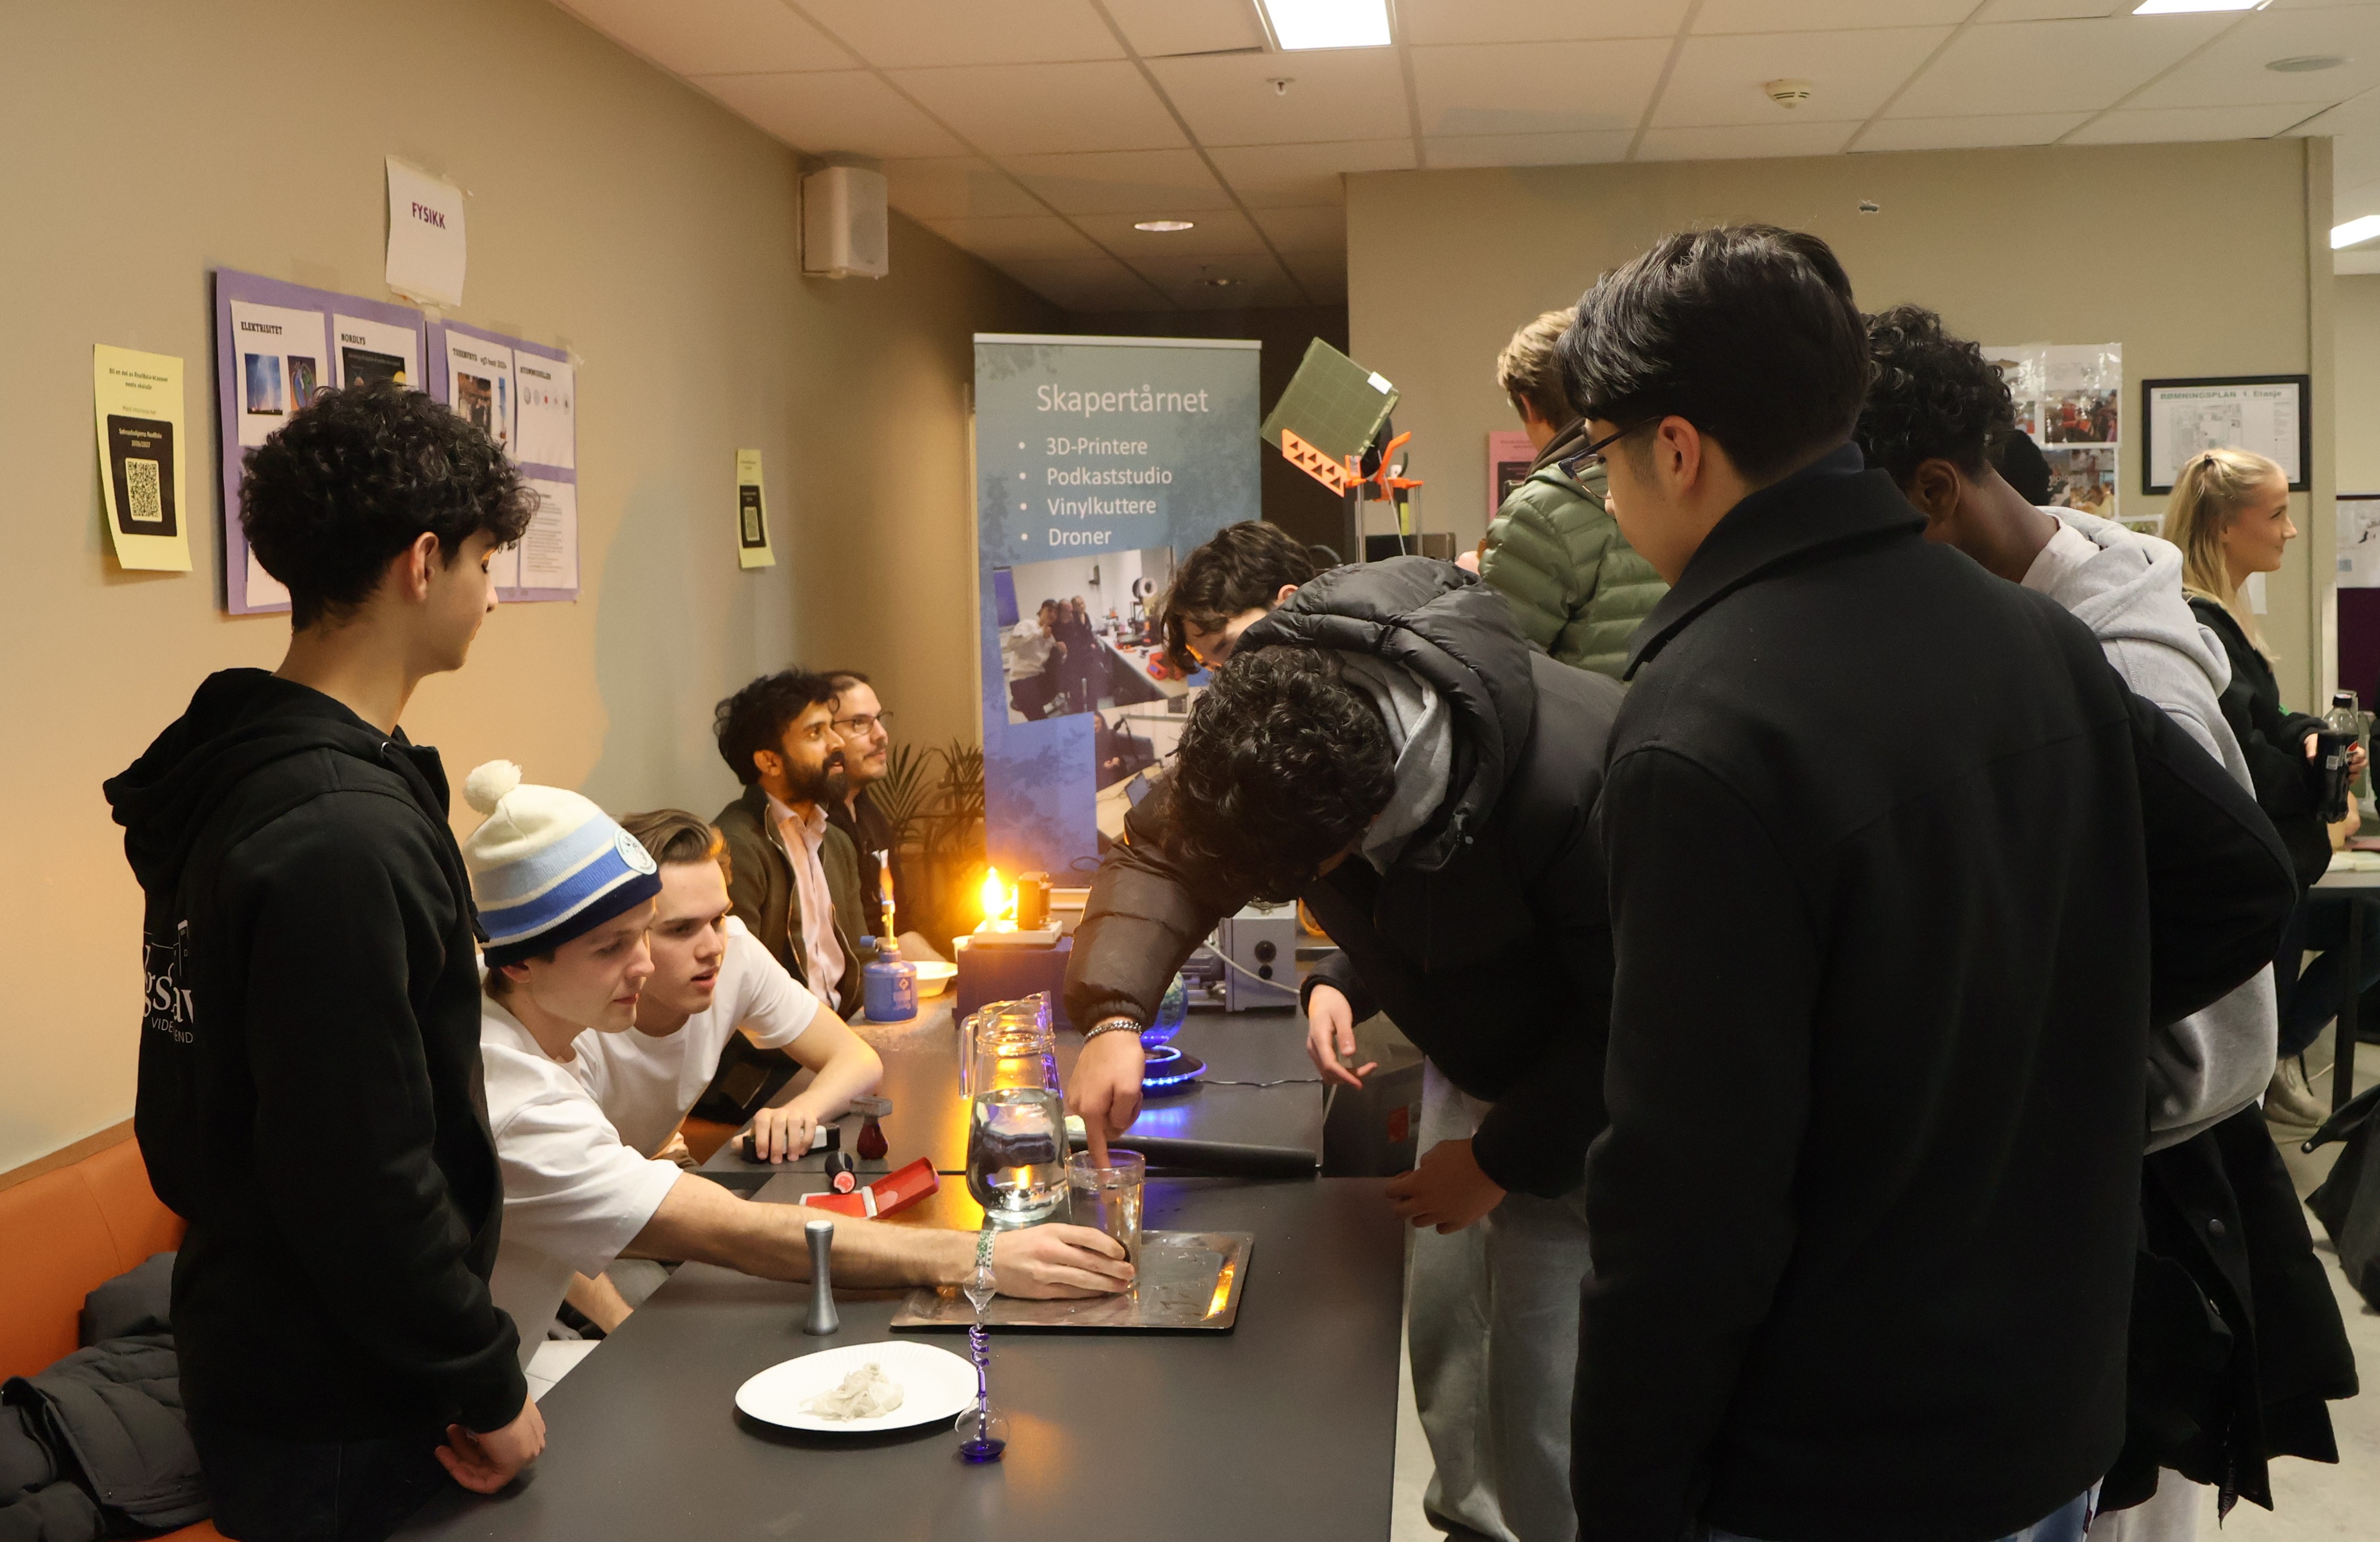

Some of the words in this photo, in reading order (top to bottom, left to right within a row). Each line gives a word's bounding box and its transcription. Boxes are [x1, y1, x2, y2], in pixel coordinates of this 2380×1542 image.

[412, 202, 446, 229] FYSIKK
[241, 321, 282, 335] ELEKTRISITET
[341, 333, 366, 345] NORDLYS
[1037, 384, 1209, 417] Skapertårnet
[1046, 437, 1148, 455] 3D-Printere
[1047, 467, 1172, 485] Podkaststudio
[1048, 497, 1157, 519] Vinylkuttere
[1049, 528, 1112, 546] Droner
